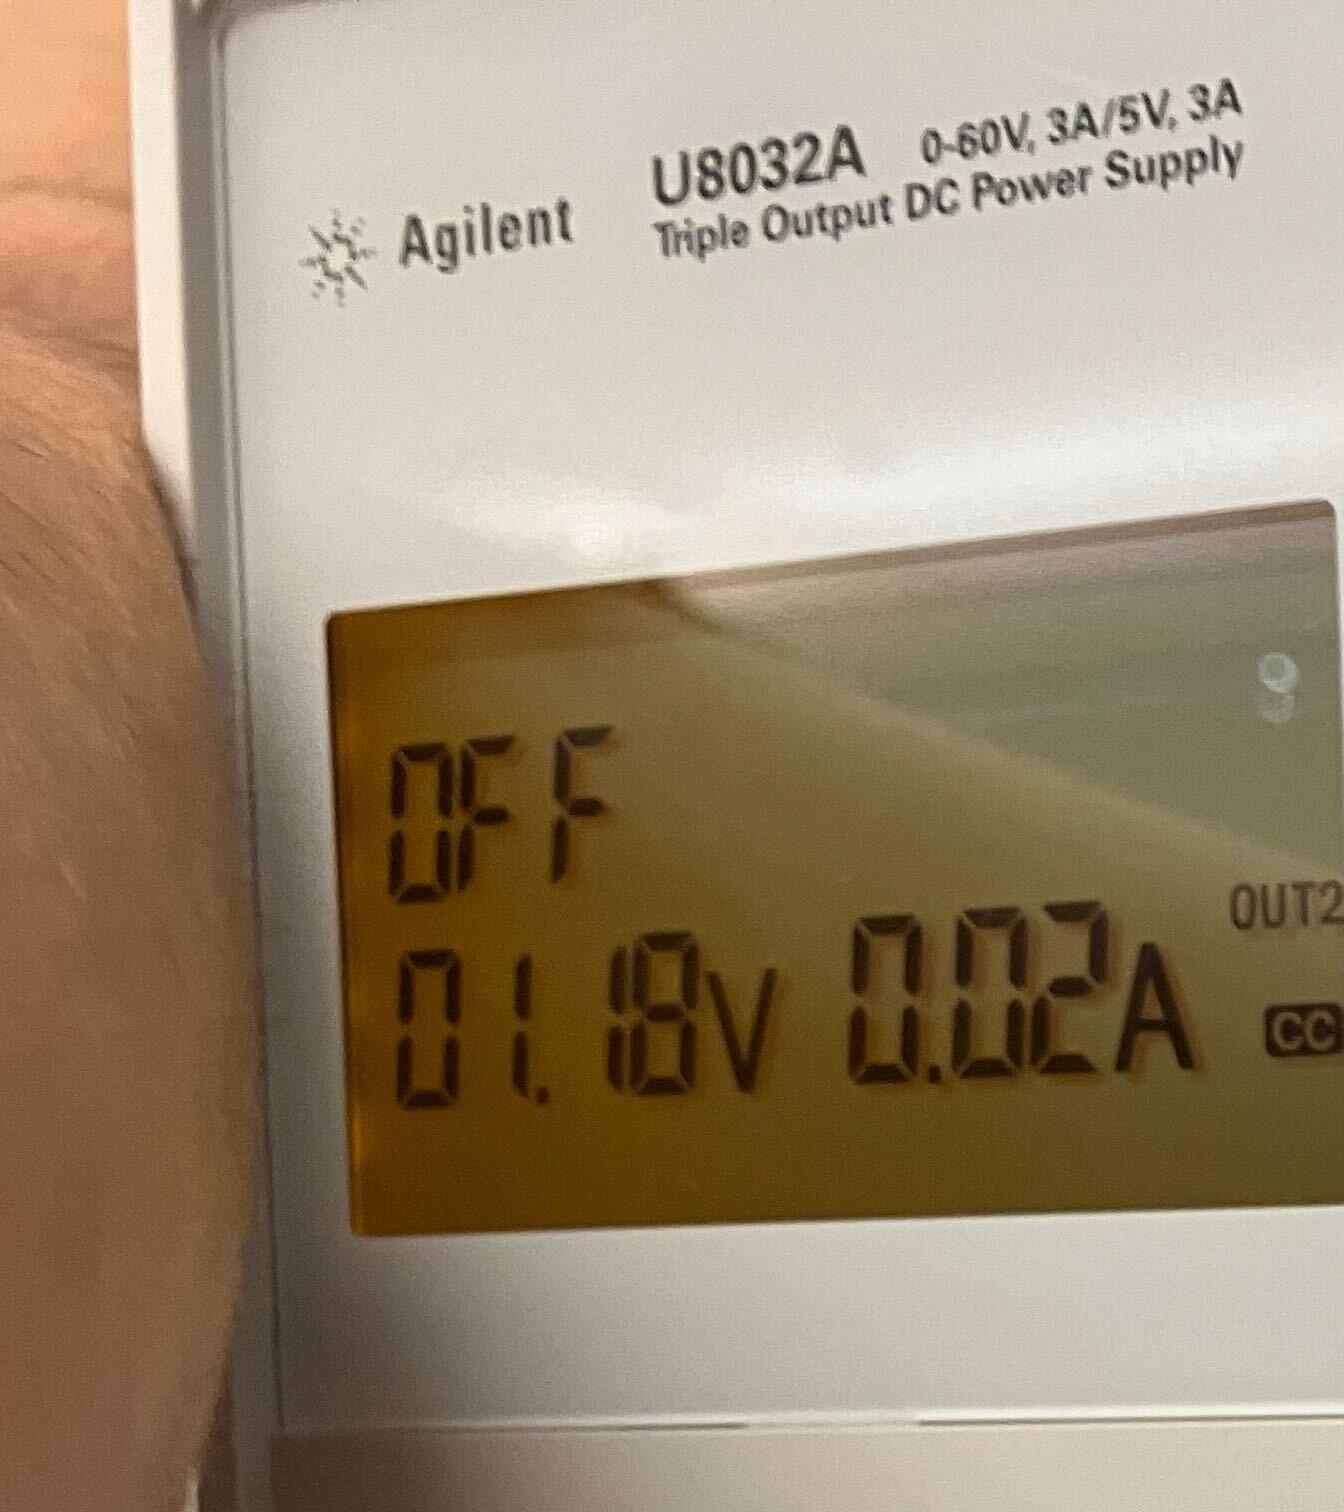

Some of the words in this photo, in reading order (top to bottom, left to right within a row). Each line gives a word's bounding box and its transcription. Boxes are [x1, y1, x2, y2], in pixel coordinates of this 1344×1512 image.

[653, 124, 867, 208] U8032A
[1189, 77, 1243, 122] 3A
[653, 213, 750, 261] Triple
[760, 194, 893, 243] Output
[906, 177, 961, 221] DC
[971, 165, 1092, 211] Power
[1104, 131, 1244, 190] Supply
[400, 198, 575, 274] Agilent
[1229, 879, 1344, 931] OUT2
[1270, 1008, 1339, 1053] CC
